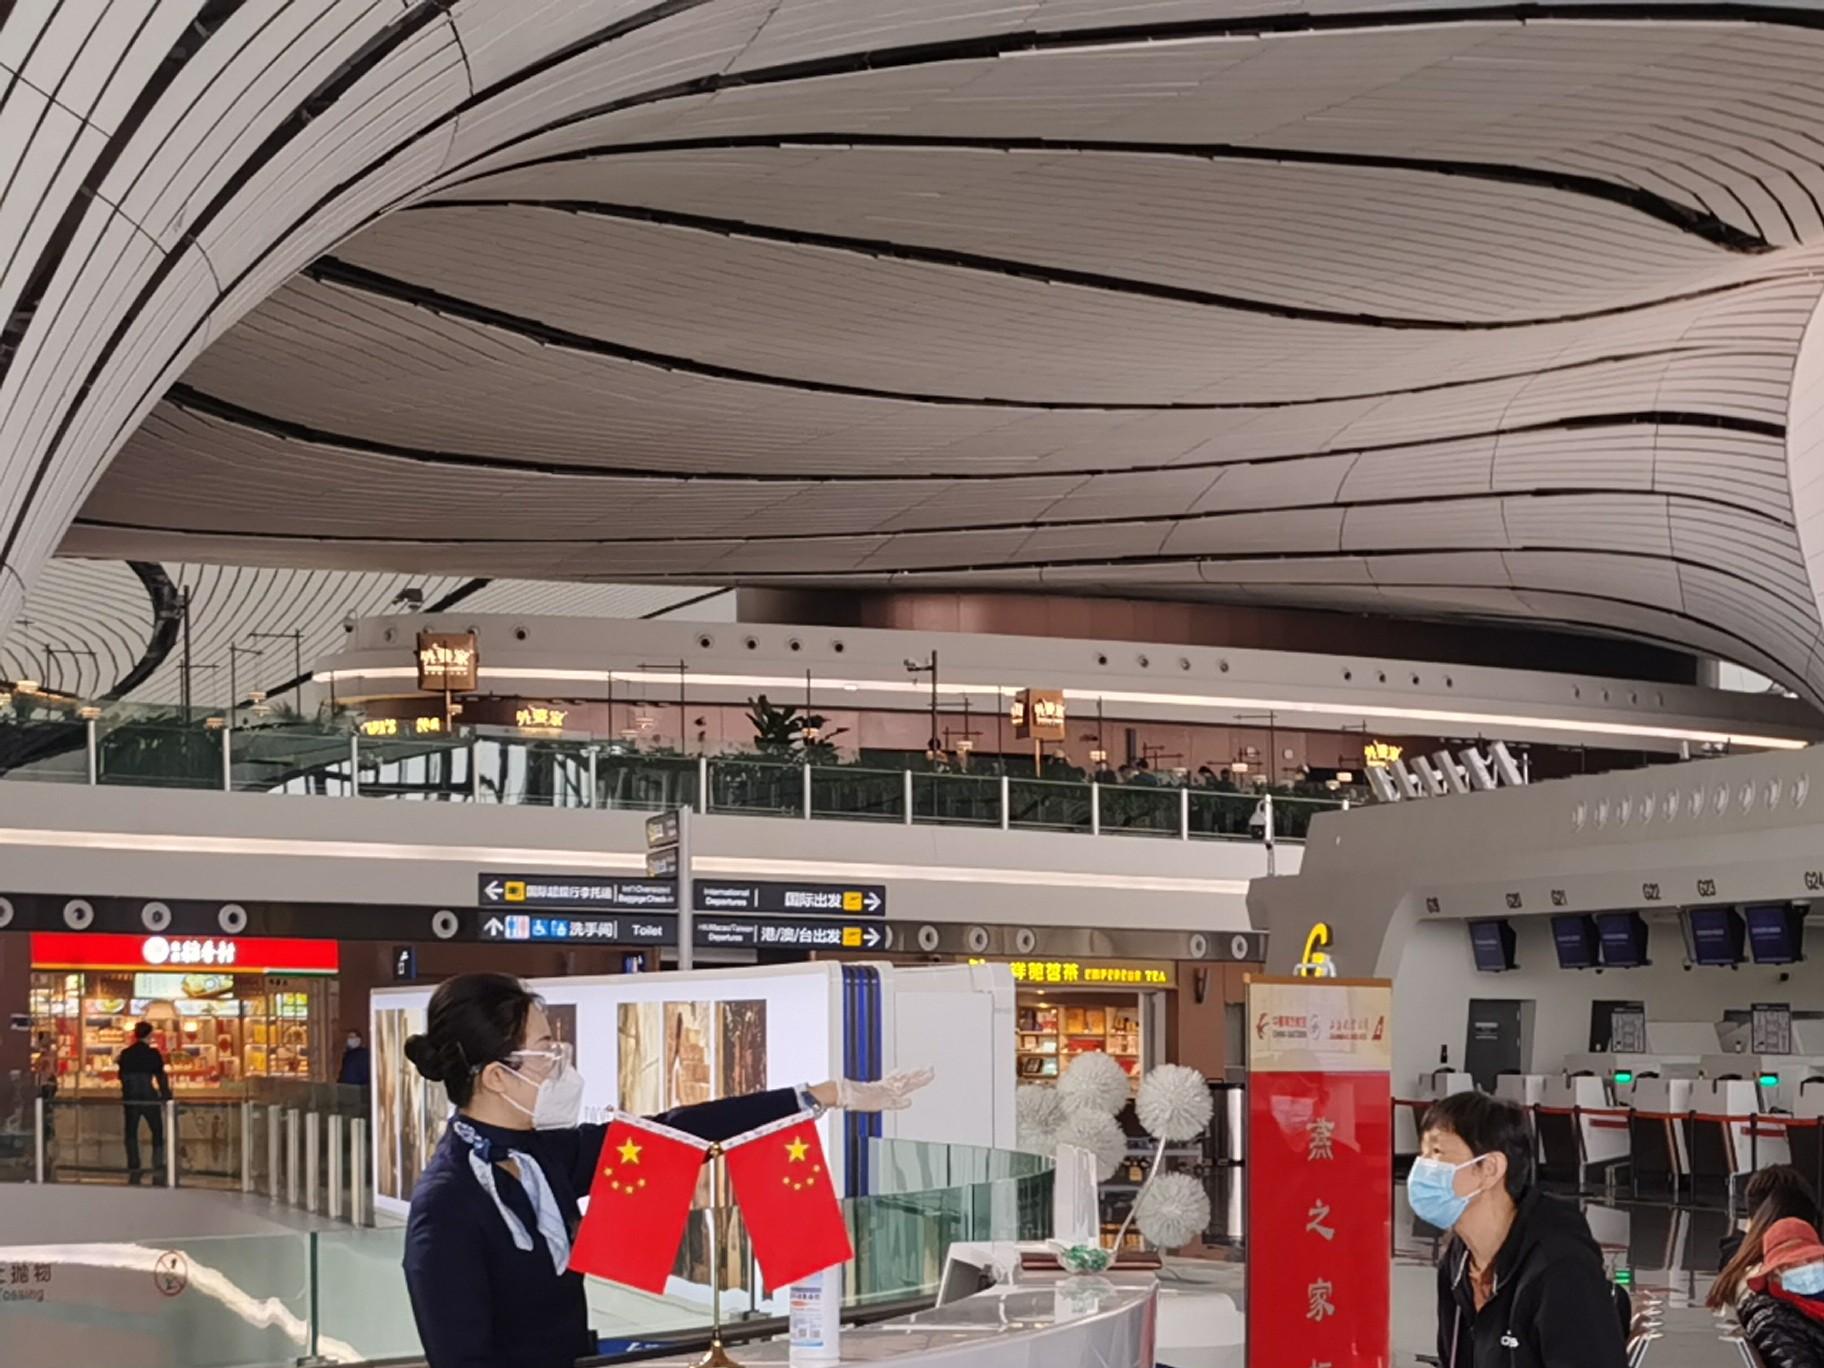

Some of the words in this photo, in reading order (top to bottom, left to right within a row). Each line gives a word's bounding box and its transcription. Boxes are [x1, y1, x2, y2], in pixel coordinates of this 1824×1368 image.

[784, 891, 842, 908] 国际出发
[569, 921, 614, 938] 洗手间
[631, 924, 663, 937] Toilet
